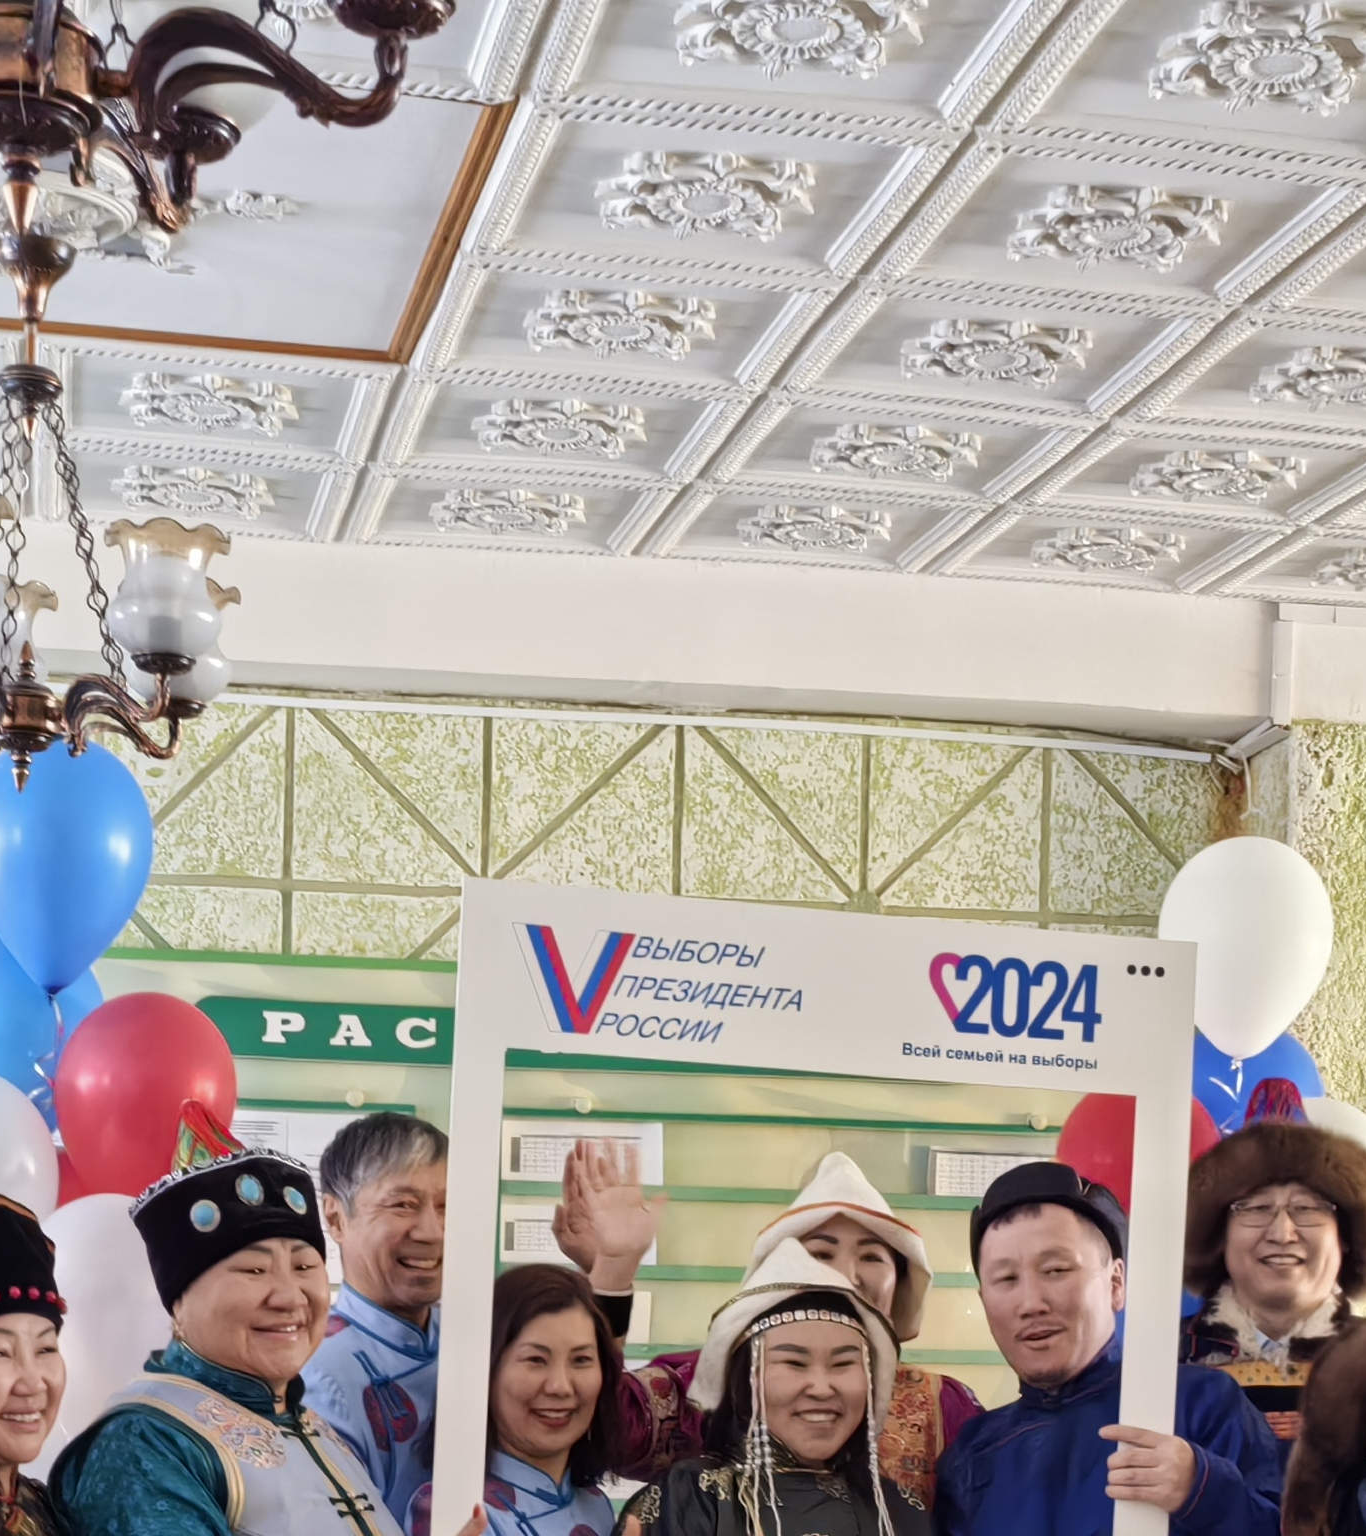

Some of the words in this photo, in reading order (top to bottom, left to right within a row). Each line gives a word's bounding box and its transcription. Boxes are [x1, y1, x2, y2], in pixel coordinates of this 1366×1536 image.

[632, 936, 765, 968] ВЫБОРЫ
[613, 975, 804, 1012] ПРЕЗИДЕНТА
[951, 953, 1103, 1043] 2024
[595, 1012, 723, 1044] РОССИИ
[902, 1042, 941, 1059] Всей
[946, 1047, 1004, 1063] семьей
[1009, 1053, 1027, 1065] на
[1032, 1054, 1097, 1071] выборы
